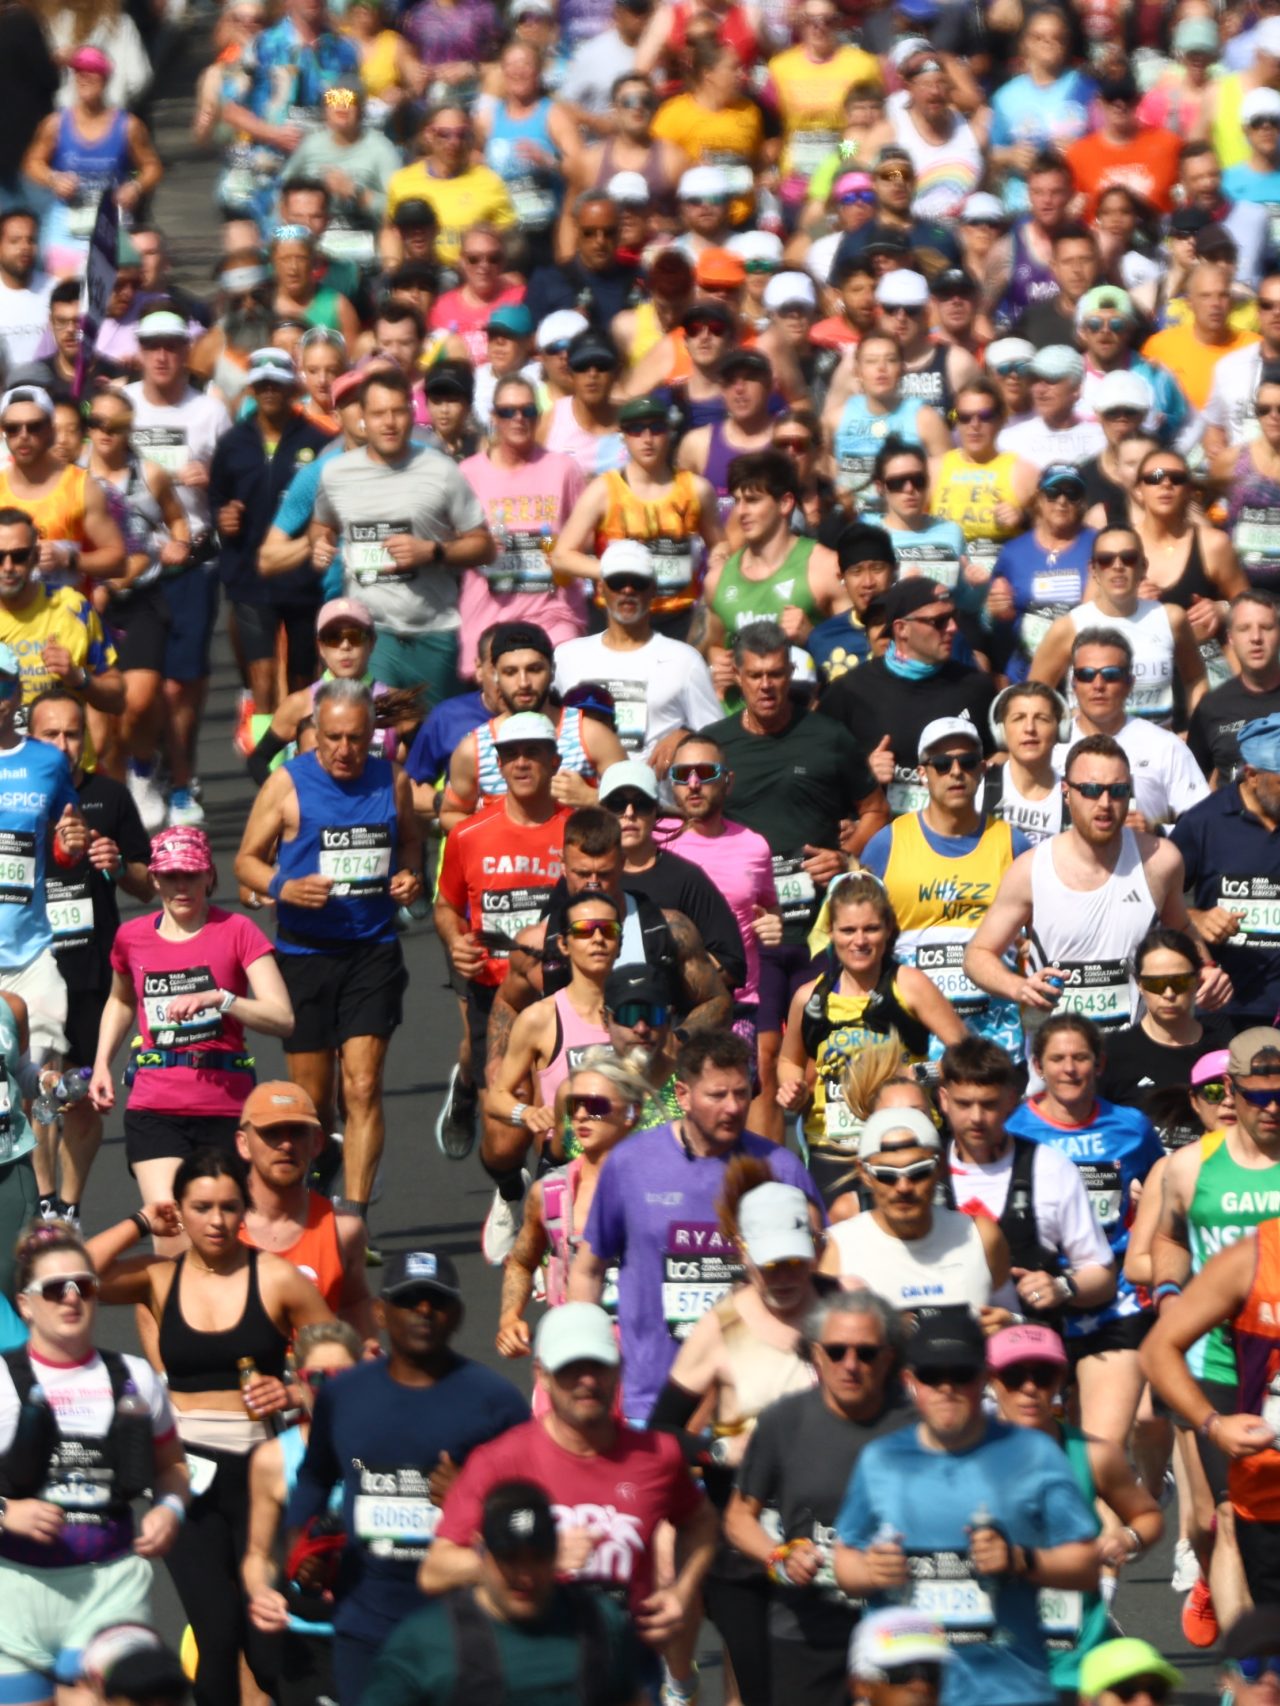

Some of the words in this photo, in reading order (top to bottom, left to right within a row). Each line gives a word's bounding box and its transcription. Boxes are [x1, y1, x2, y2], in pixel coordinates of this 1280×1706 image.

[0, 791, 47, 808] SPICE
[1009, 808, 1050, 828] LUCY
[0, 838, 33, 847] ONSULTANCY
[323, 830, 350, 847] tcs
[351, 832, 387, 840] CONSULTANCY
[331, 855, 382, 878] 78747
[776, 880, 803, 898] 49
[1221, 876, 1249, 896] tcs
[1251, 889, 1277, 897] SERVICES
[483, 891, 510, 910] tcs
[512, 900, 537, 908] SERVICES
[918, 948, 944, 967] tcs
[169, 975, 209, 986] CONSULTANCY
[1064, 967, 1082, 985] cs
[1084, 968, 1125, 977] CONSULTANCY
[1084, 976, 1111, 984] SERVICES
[144, 976, 168, 994] tcs
[170, 982, 197, 992] SERVICES
[930, 974, 979, 994] 868
[1064, 991, 1118, 1014] 76434
[190, 1029, 217, 1040] balance
[675, 1228, 731, 1247] RYA
[667, 1257, 700, 1279] tcs
[702, 1263, 746, 1271] CONSULTANCY
[702, 1270, 731, 1278] SERVICES
